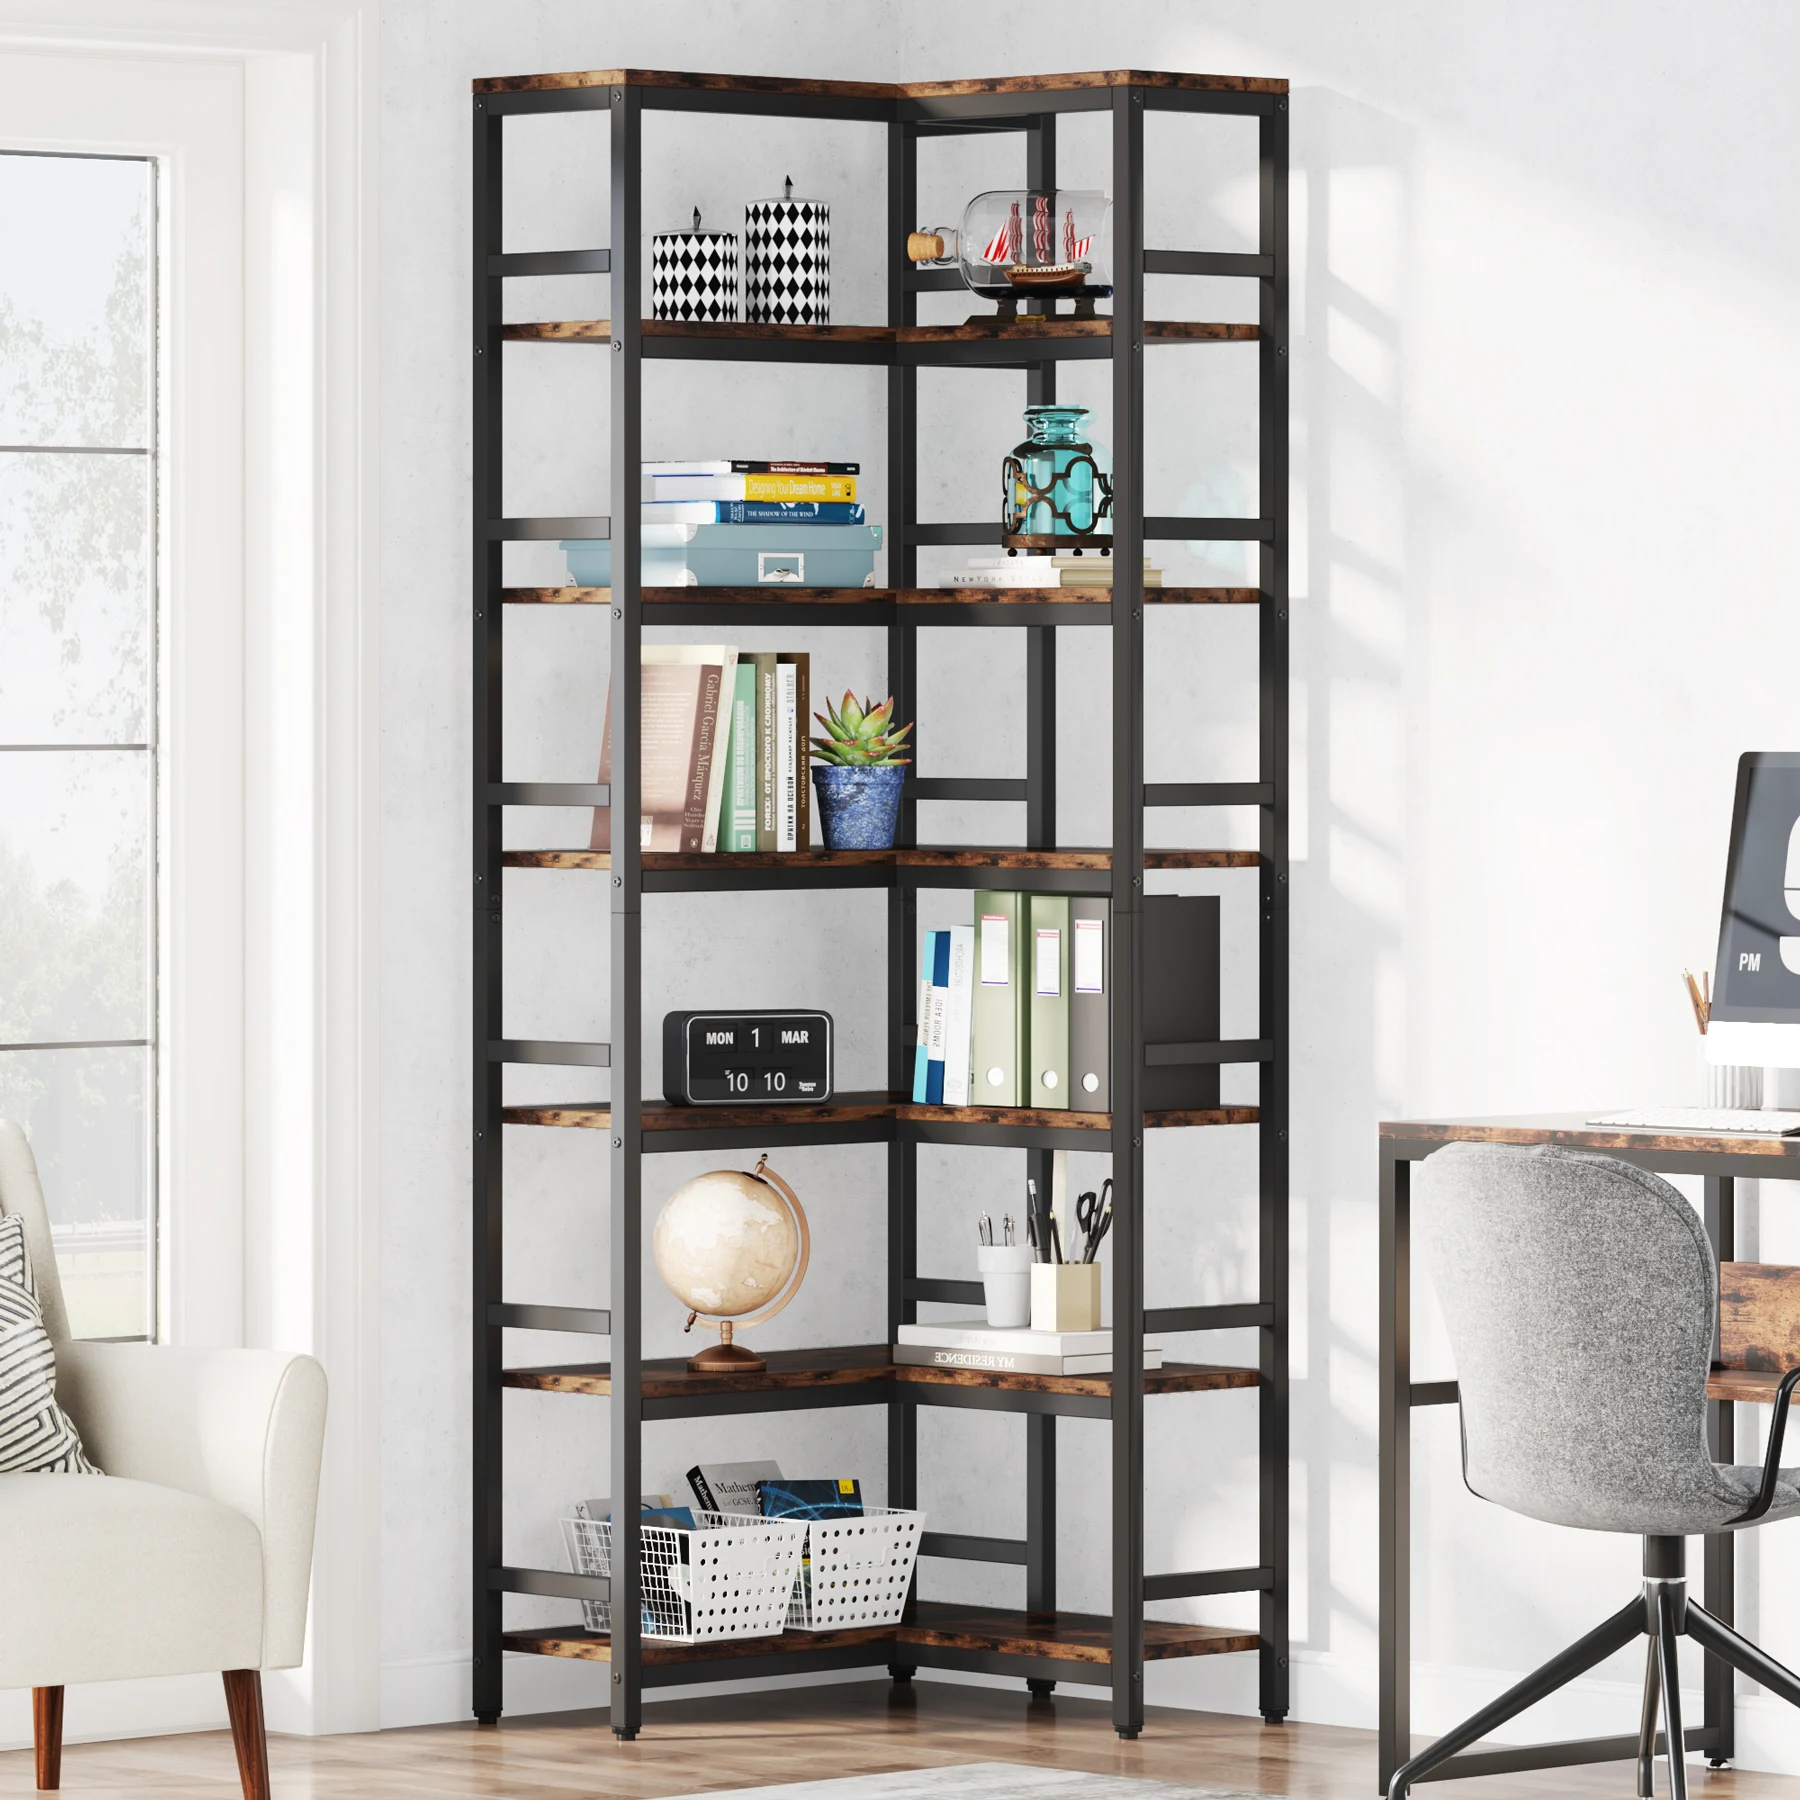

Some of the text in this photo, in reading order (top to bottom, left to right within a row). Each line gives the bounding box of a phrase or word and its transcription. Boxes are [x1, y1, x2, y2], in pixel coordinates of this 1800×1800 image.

[748, 479, 826, 498] Designing Your Dream Home
[764, 673, 772, 727] СЛОЖНОМУ
[692, 674, 720, 801] Gabriel García Márquez
[765, 782, 771, 794] ОТ
[786, 776, 794, 802] ОСЕВОЙ
[787, 804, 794, 813] НА
[1738, 953, 1761, 972] PM
[706, 1028, 809, 1048] MON 1 MAR
[726, 1072, 786, 1092] 10 10
[715, 1482, 755, 1494] Mathem
